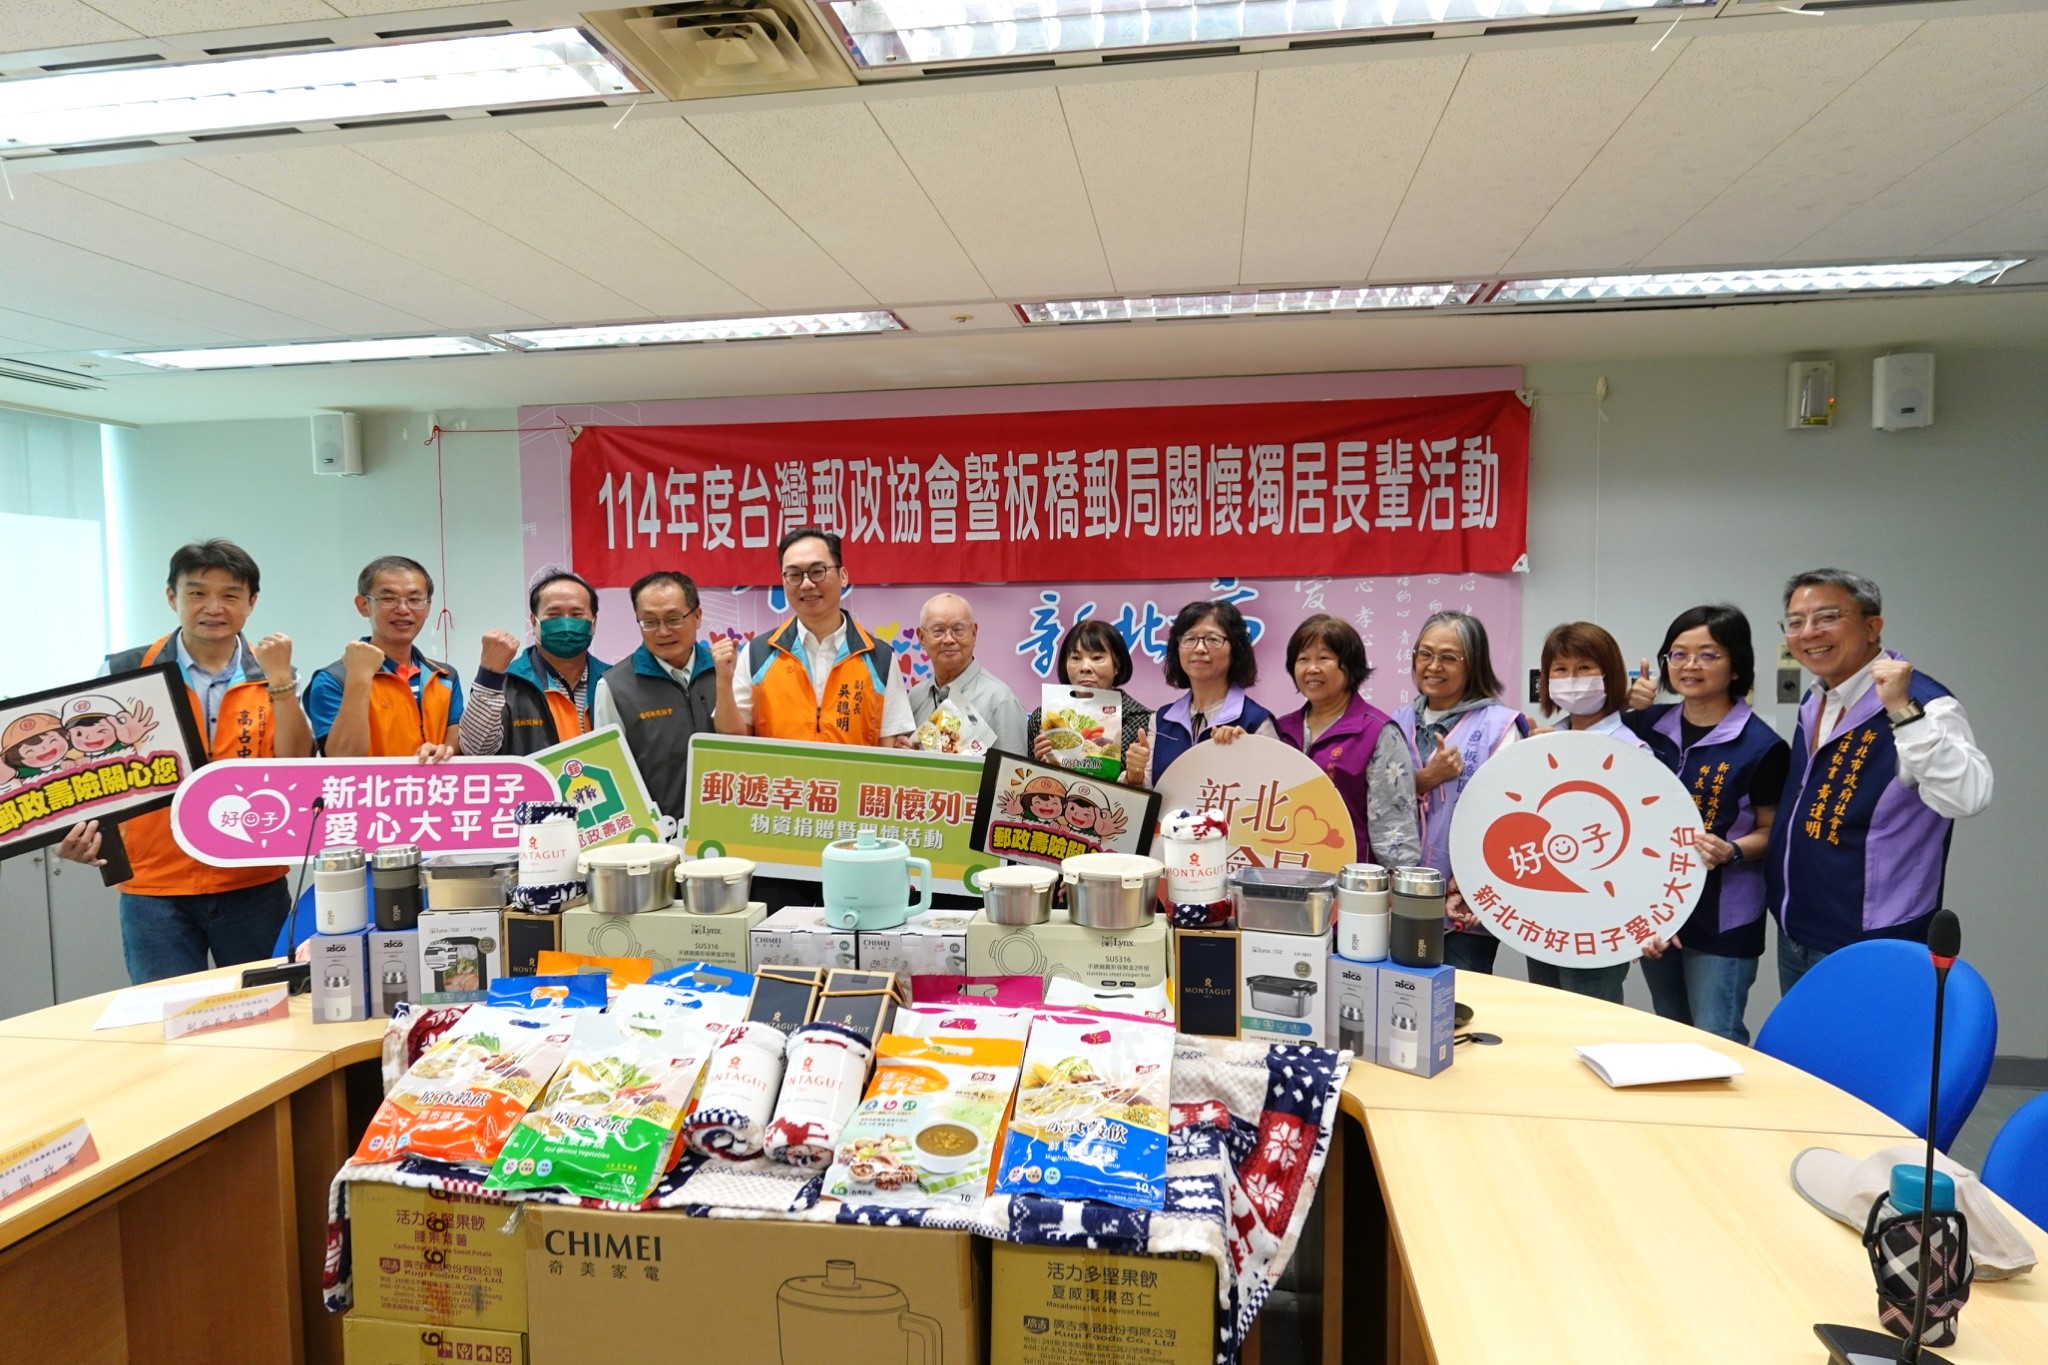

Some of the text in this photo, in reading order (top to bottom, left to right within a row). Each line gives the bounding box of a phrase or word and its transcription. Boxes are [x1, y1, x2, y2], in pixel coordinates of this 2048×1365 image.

[599, 434, 1499, 552] 114年度台灣郵政協會暨板橋郵局關懷獨居長輩活動
[836, 683, 851, 733] 吳聰明
[853, 680, 864, 715] 副局長
[236, 709, 253, 758] 高占中
[0, 757, 179, 834] 郵政壽險關心您
[322, 773, 526, 809] 新北市好日子
[701, 771, 840, 815] 郵遞幸福
[1826, 729, 1878, 845] 新北市政府社會局
[1196, 778, 1290, 841] 新北
[324, 810, 520, 846] 愛心大平台
[520, 849, 567, 861] NTAGUT
[993, 826, 1101, 859] 郵政壽險關
[1166, 864, 1225, 877] MONTAGUT
[1472, 825, 1697, 956] 新北市好日子愛心大平台
[1114, 937, 1134, 949] Lynx
[513, 965, 537, 973] MONTA
[1105, 955, 1132, 963] SUS316
[1185, 987, 1232, 996] MONTAGUT
[762, 1021, 798, 1031] NTAGUT
[578, 1150, 611, 1159] Vegetables
[960, 1194, 971, 1202] 10
[545, 1230, 662, 1262] CHIMEI
[548, 1260, 660, 1282] 奇美家電
[1047, 1261, 1159, 1289] 活力多堅果飲
[1051, 1284, 1152, 1308] 夏威夷果杏仁
[1046, 1301, 1087, 1312] Macadamia
[1108, 1307, 1135, 1317] Apricot
[1136, 1309, 1160, 1318] Kernel
[1053, 1319, 1177, 1340] 廣吉食品股份有限公司
[1054, 1330, 1082, 1340] Kugi
[1085, 1332, 1123, 1342] Foods
